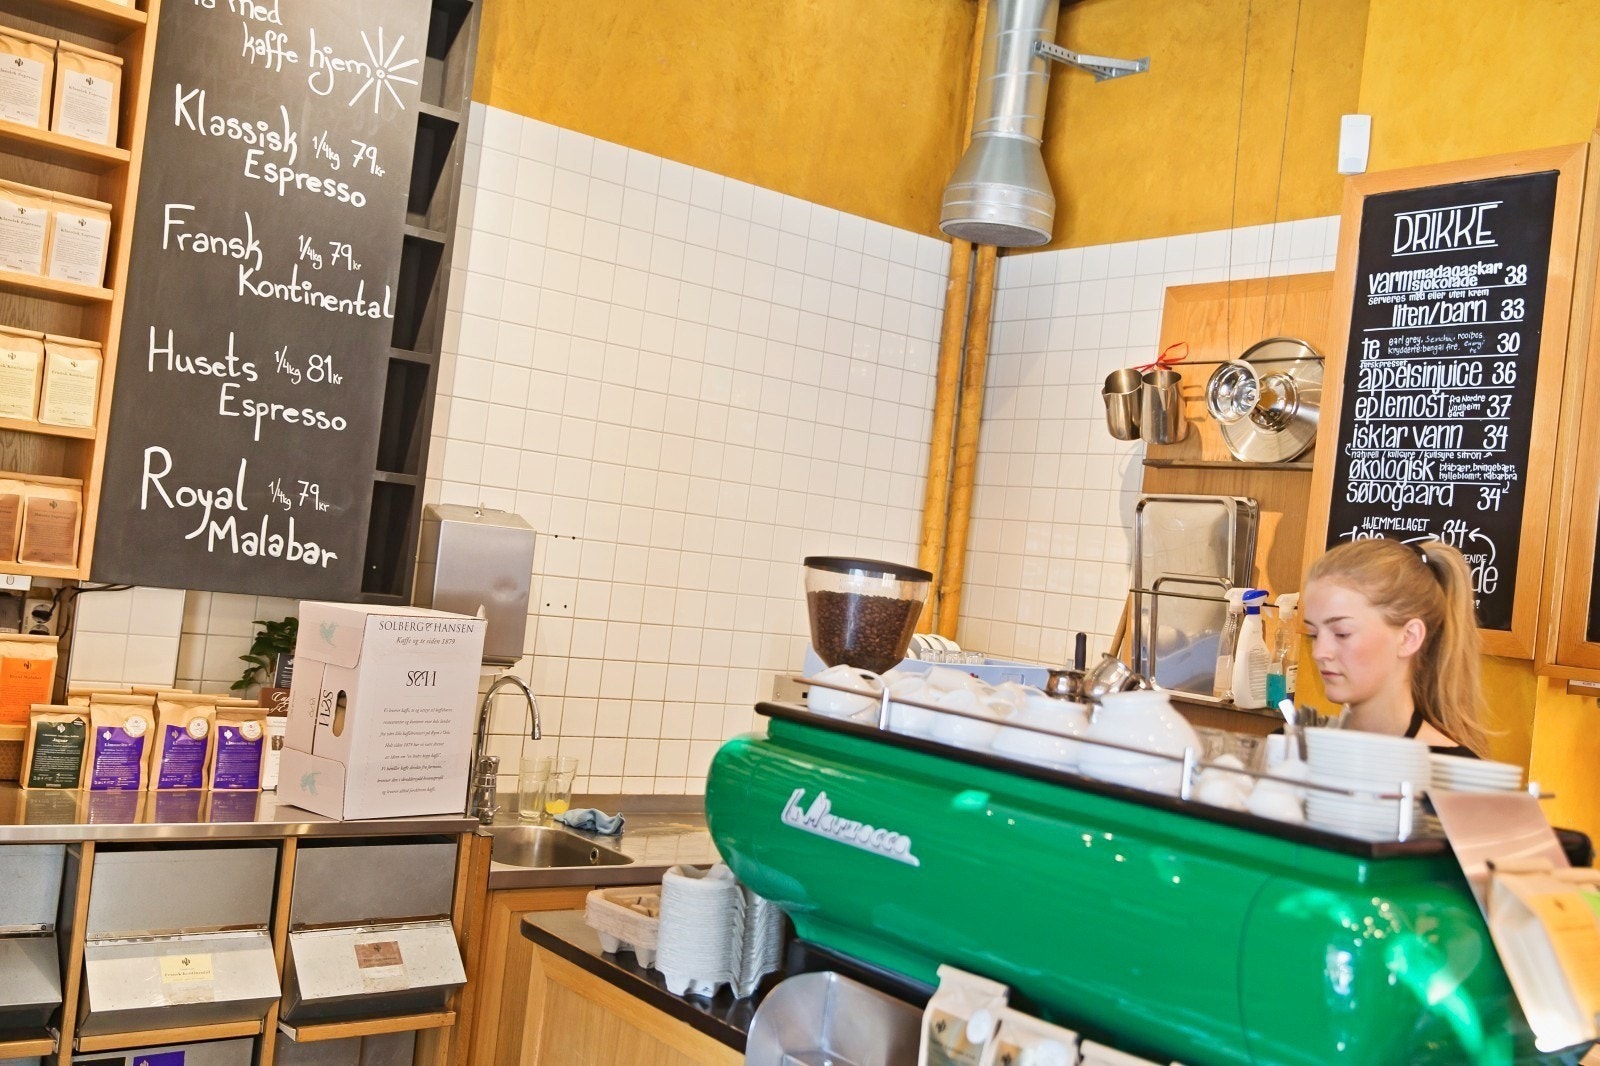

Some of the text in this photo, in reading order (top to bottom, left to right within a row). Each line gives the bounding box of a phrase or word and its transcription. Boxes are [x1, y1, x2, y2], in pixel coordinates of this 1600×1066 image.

[242, 22, 372, 96] kaffe hjem
[174, 83, 298, 165] Klassisk
[244, 149, 366, 208] Espresso
[162, 203, 263, 271] Fransk
[1393, 204, 1498, 254] DRIKKE
[238, 264, 394, 319] Kontinental
[1369, 261, 1528, 295] varm madagaskar 38
[1368, 294, 1406, 305] serveres
[1427, 291, 1446, 301] eller
[1468, 288, 1490, 297] krem
[1500, 298, 1525, 321] 33
[148, 325, 259, 382] Husets
[1361, 337, 1381, 360] te
[1496, 332, 1521, 353] 30
[1357, 360, 1517, 394] appelsinjuice 36
[219, 383, 347, 441] Espresso
[1355, 392, 1449, 424] eplemost
[1487, 394, 1513, 418] 37
[1352, 423, 1508, 450] isklar vann 34
[1348, 457, 1436, 487] økologisk
[141, 446, 248, 540] Royal
[1477, 486, 1501, 511] 34
[208, 514, 338, 568] Malabar
[1361, 516, 1431, 532] HJEMMELAGET
[1441, 519, 1469, 549] 34
